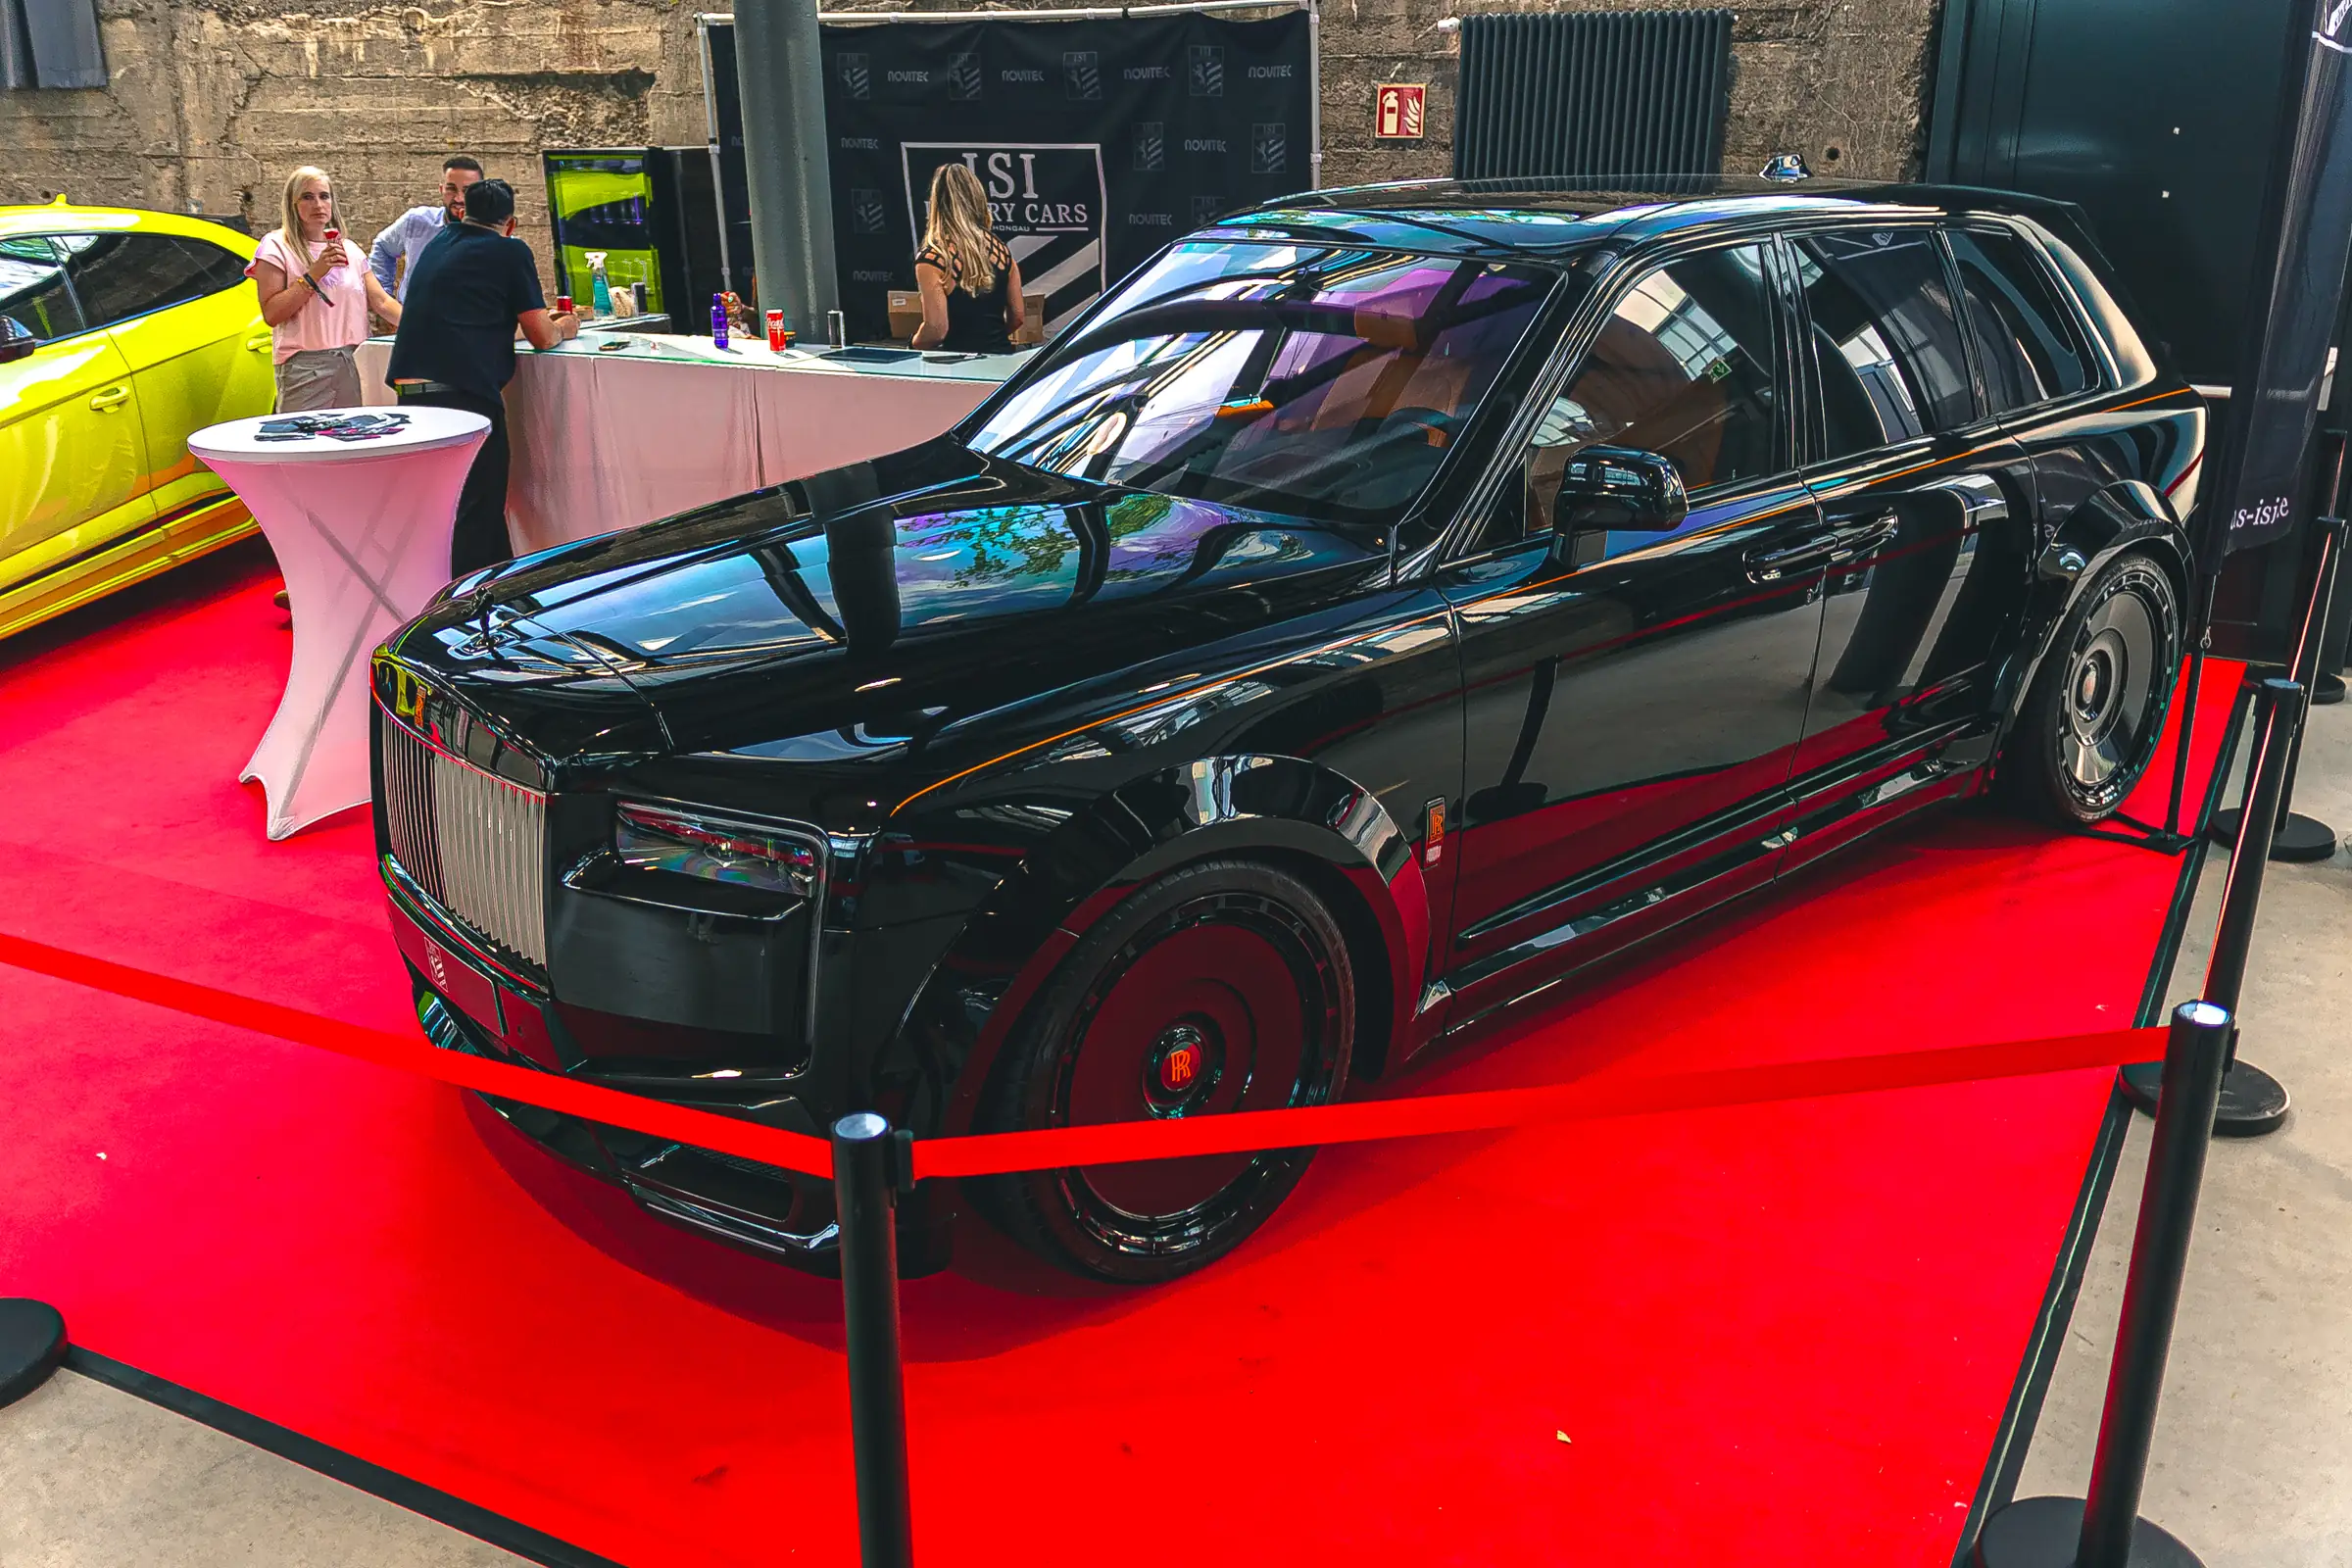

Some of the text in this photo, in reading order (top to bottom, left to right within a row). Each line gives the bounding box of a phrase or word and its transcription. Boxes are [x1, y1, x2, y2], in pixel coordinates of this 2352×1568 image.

[888, 71, 929, 82] NOVITEC
[1002, 70, 1045, 82] NOVITEC
[1124, 66, 1170, 79] NOVITEC
[1248, 64, 1292, 78] NOVITEC
[1184, 139, 1227, 153] NOVITEC
[1025, 203, 1088, 223] CARS
[1128, 214, 1172, 226] NOVITEC
